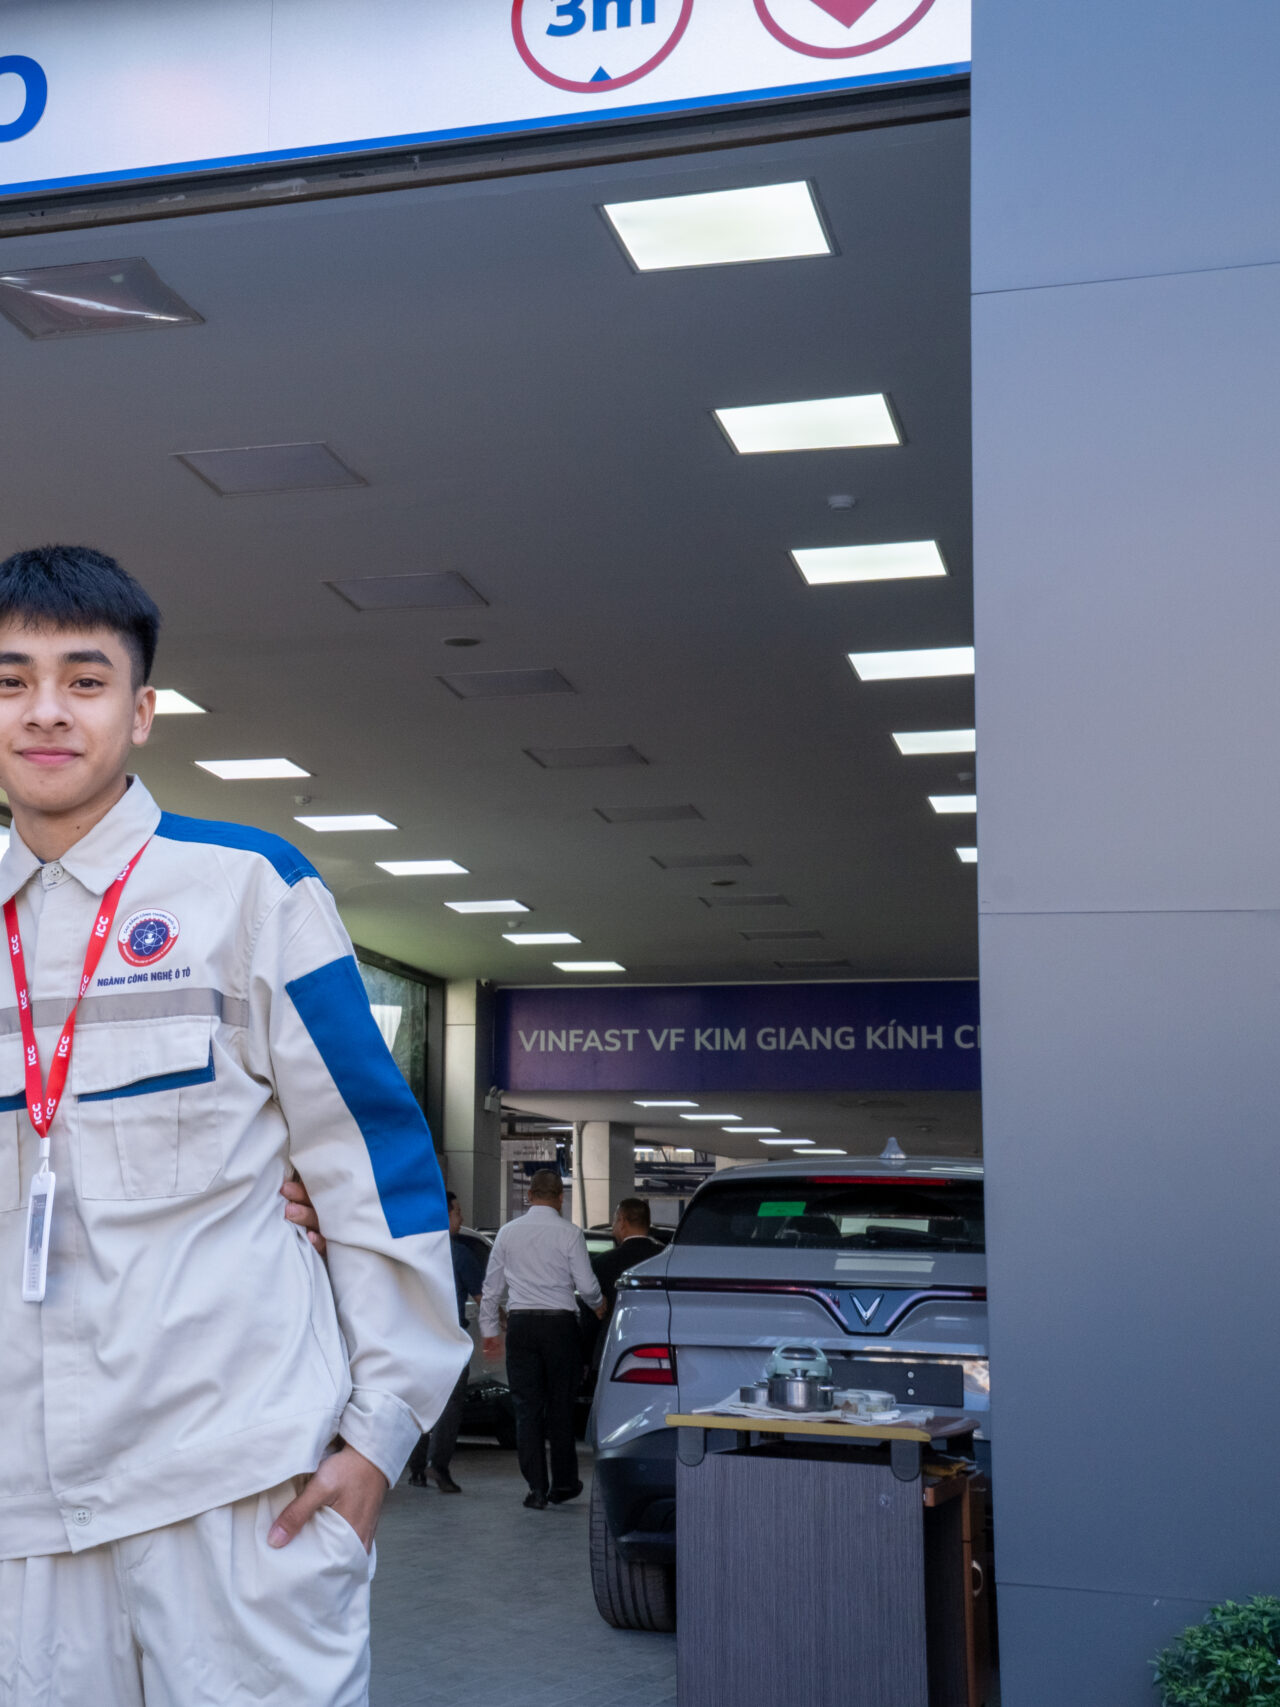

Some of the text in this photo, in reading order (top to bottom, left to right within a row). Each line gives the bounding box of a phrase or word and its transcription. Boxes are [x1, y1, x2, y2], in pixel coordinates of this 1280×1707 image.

[546, 0, 656, 37] 3m
[95, 915, 109, 937] ICC
[11, 934, 20, 955] ICC
[97, 966, 191, 987] NGÀNH CÔNG NGHỆ Ô TÔ
[20, 989, 28, 1010] ICC
[57, 1035, 70, 1057] ICC
[518, 1029, 639, 1052] VINFAST
[647, 1028, 685, 1052] VF
[694, 1027, 746, 1051] KIM
[756, 1026, 855, 1050] GIANG
[866, 1018, 943, 1050] KÍNH
[27, 1044, 37, 1066] ICC
[32, 1102, 42, 1125] ICC
[45, 1098, 56, 1120] ICC
